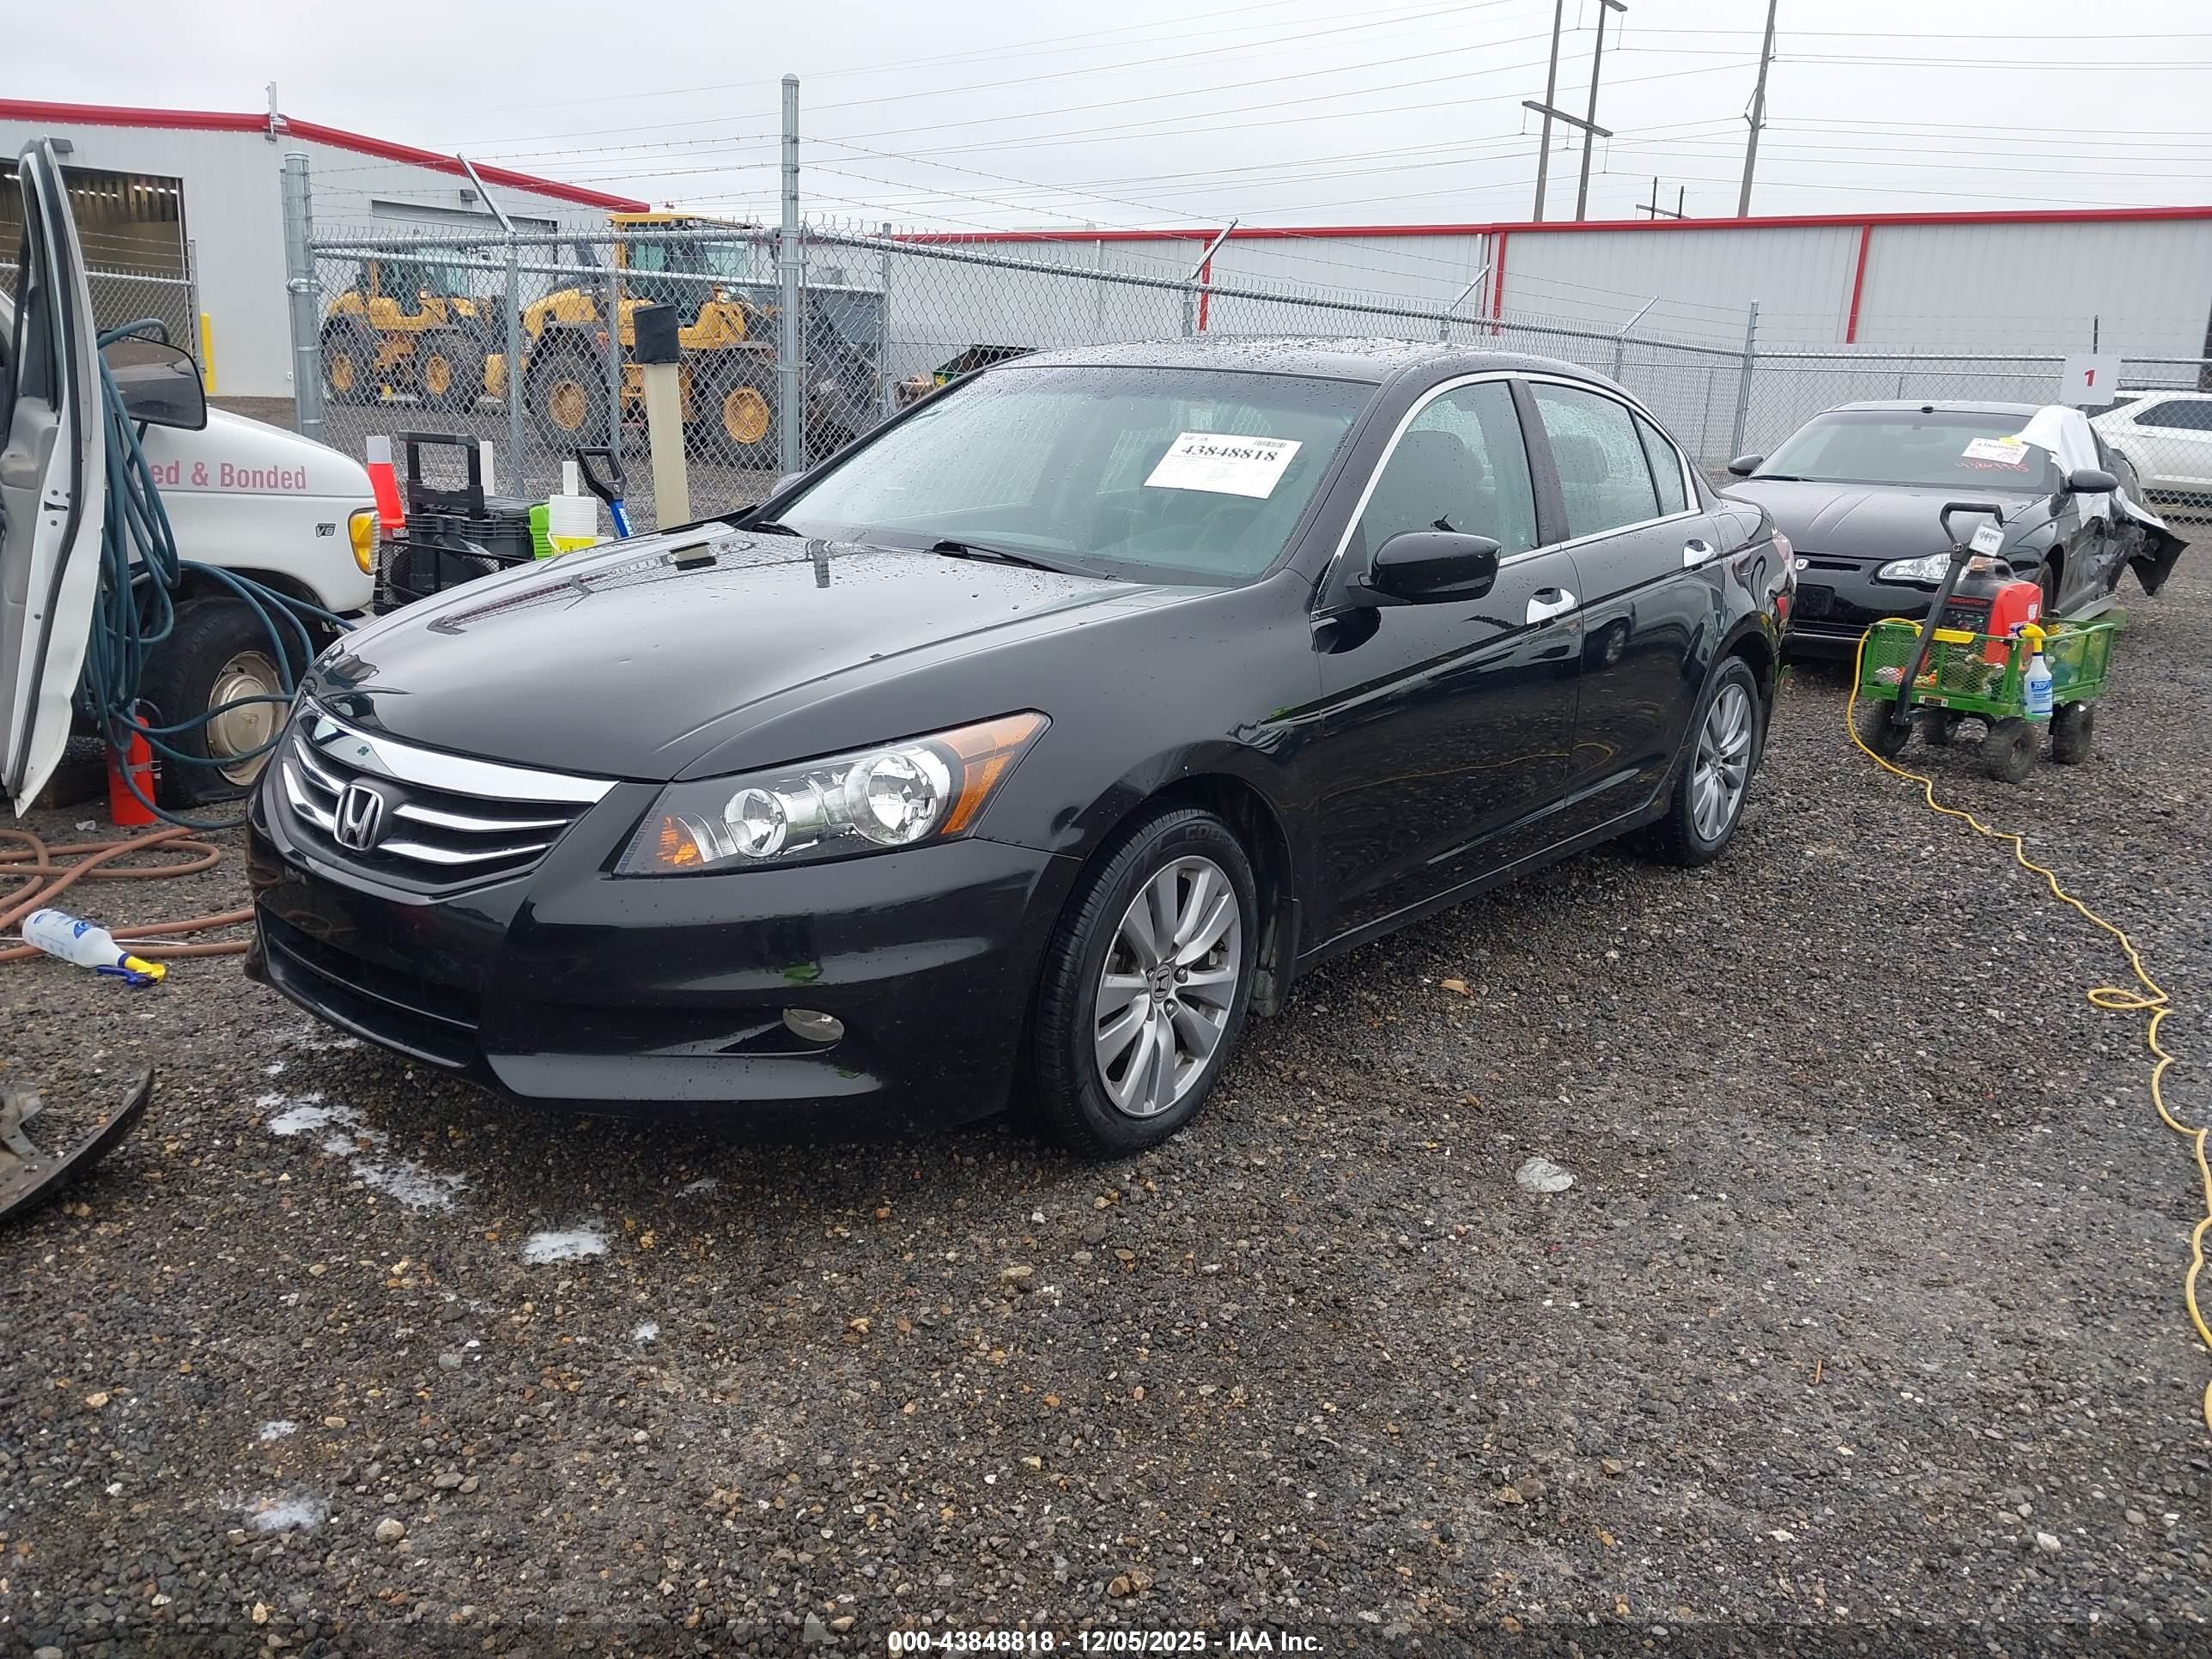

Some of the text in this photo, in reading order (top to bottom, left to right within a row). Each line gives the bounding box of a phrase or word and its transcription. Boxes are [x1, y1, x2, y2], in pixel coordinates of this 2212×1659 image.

[2085, 369, 2095, 386] 1
[1182, 445, 1279, 462] 43848818
[148, 460, 307, 489] ed & Bonded
[316, 526, 334, 537] V8
